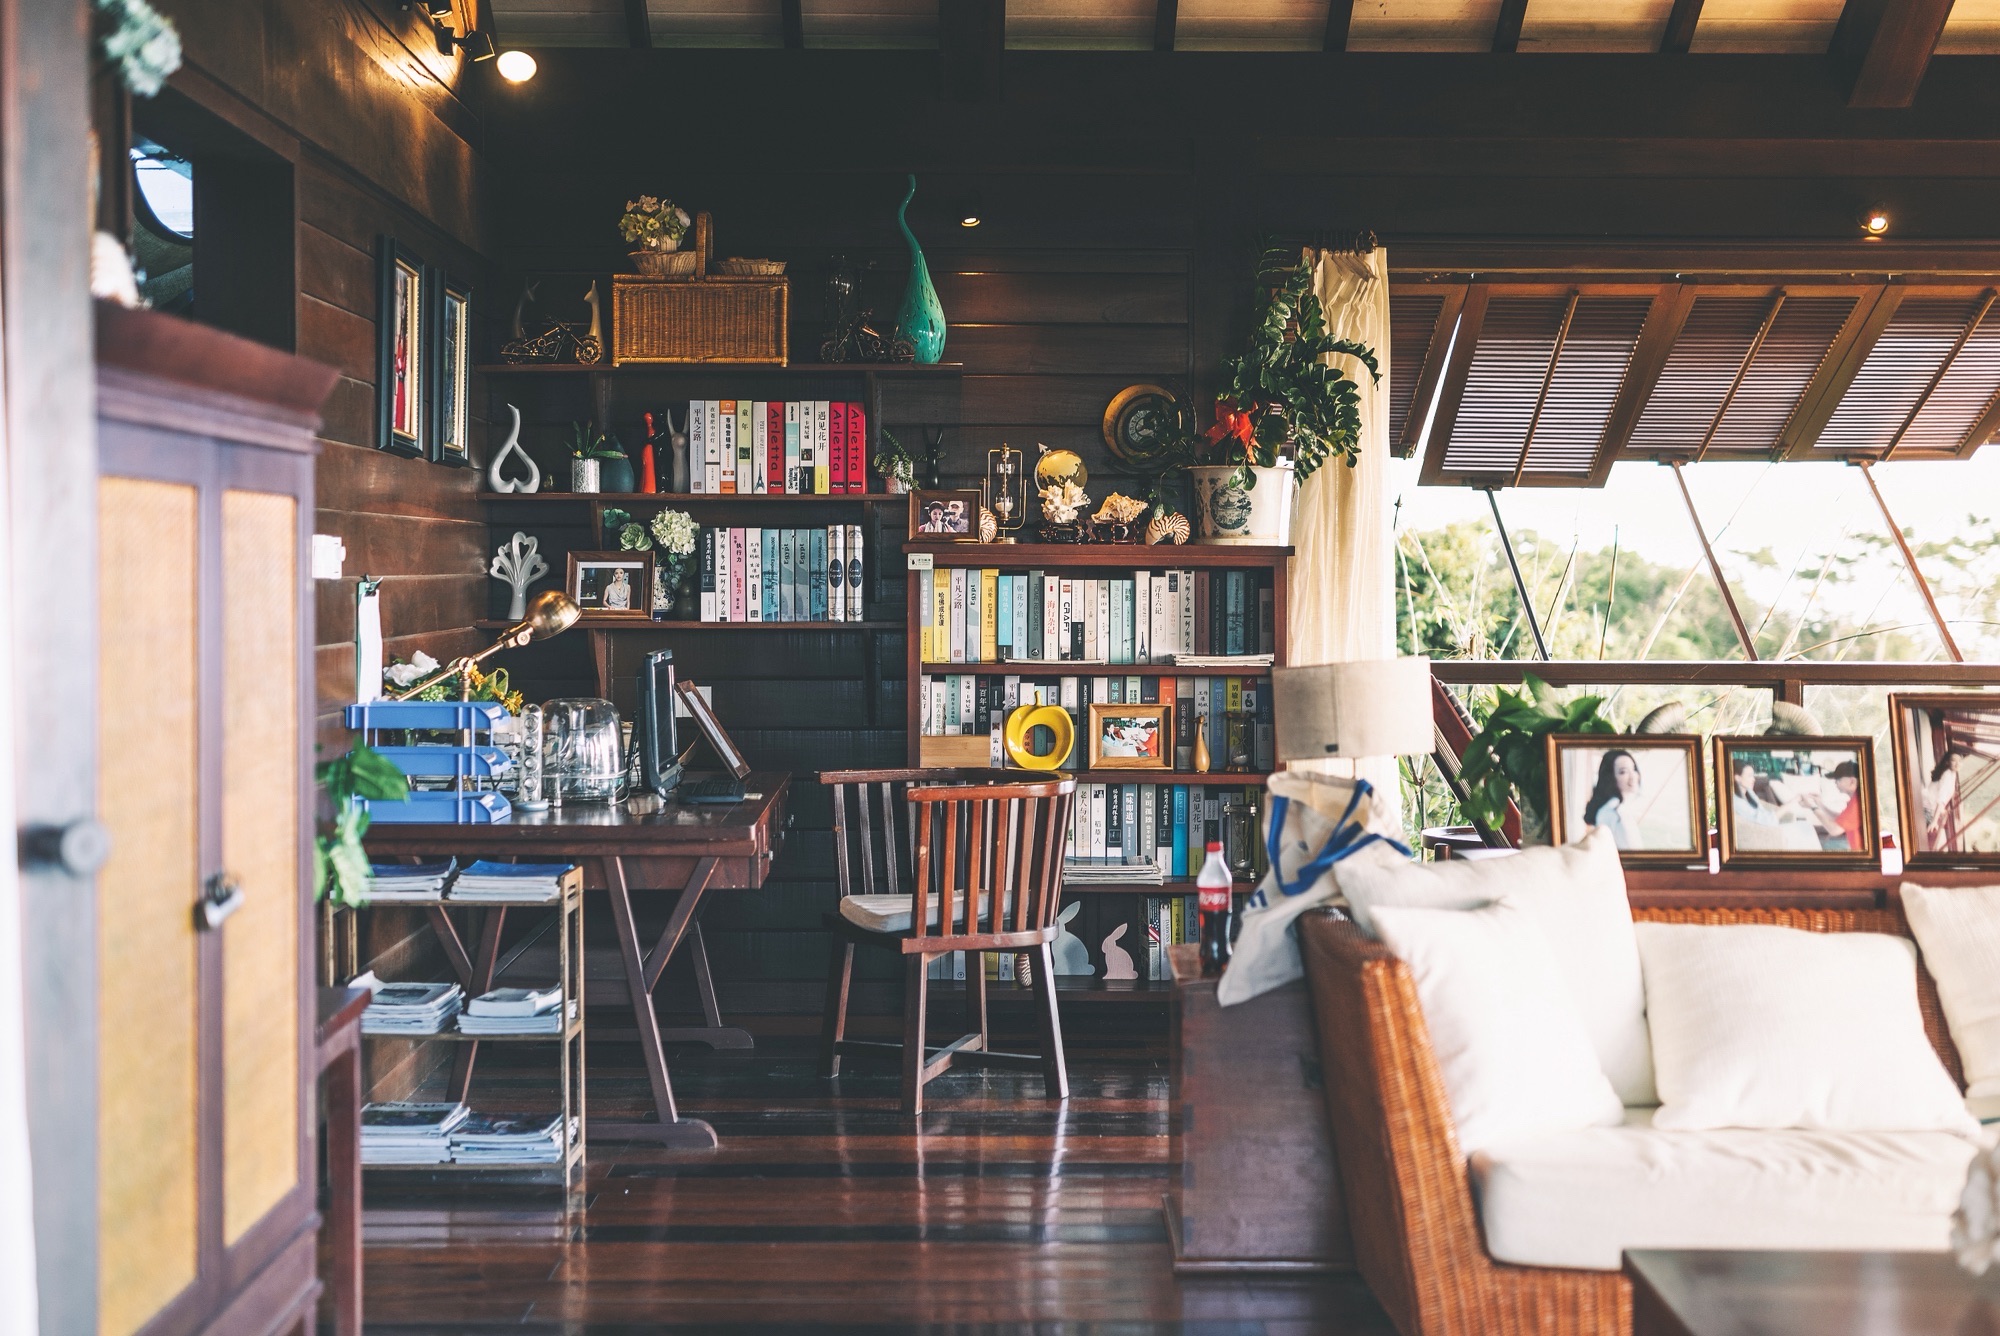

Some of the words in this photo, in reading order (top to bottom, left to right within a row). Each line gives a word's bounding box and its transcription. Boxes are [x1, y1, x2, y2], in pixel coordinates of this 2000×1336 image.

[693, 408, 702, 442] 平凡之路
[770, 408, 780, 471] Arletta
[817, 411, 827, 451] 遇见花开
[833, 409, 843, 471] Arletta
[850, 408, 861, 471] Arletta
[783, 543, 791, 565] Egypt
[953, 576, 963, 610] 平凡之路
[1016, 584, 1024, 618] 朝花夕拾
[979, 688, 987, 723] 百年孤独
[1079, 790, 1088, 824] 老人与海
[1192, 792, 1202, 833] 遇见花开
[1094, 820, 1102, 845] 稻草人
[1189, 902, 1197, 937] 狂人日记
